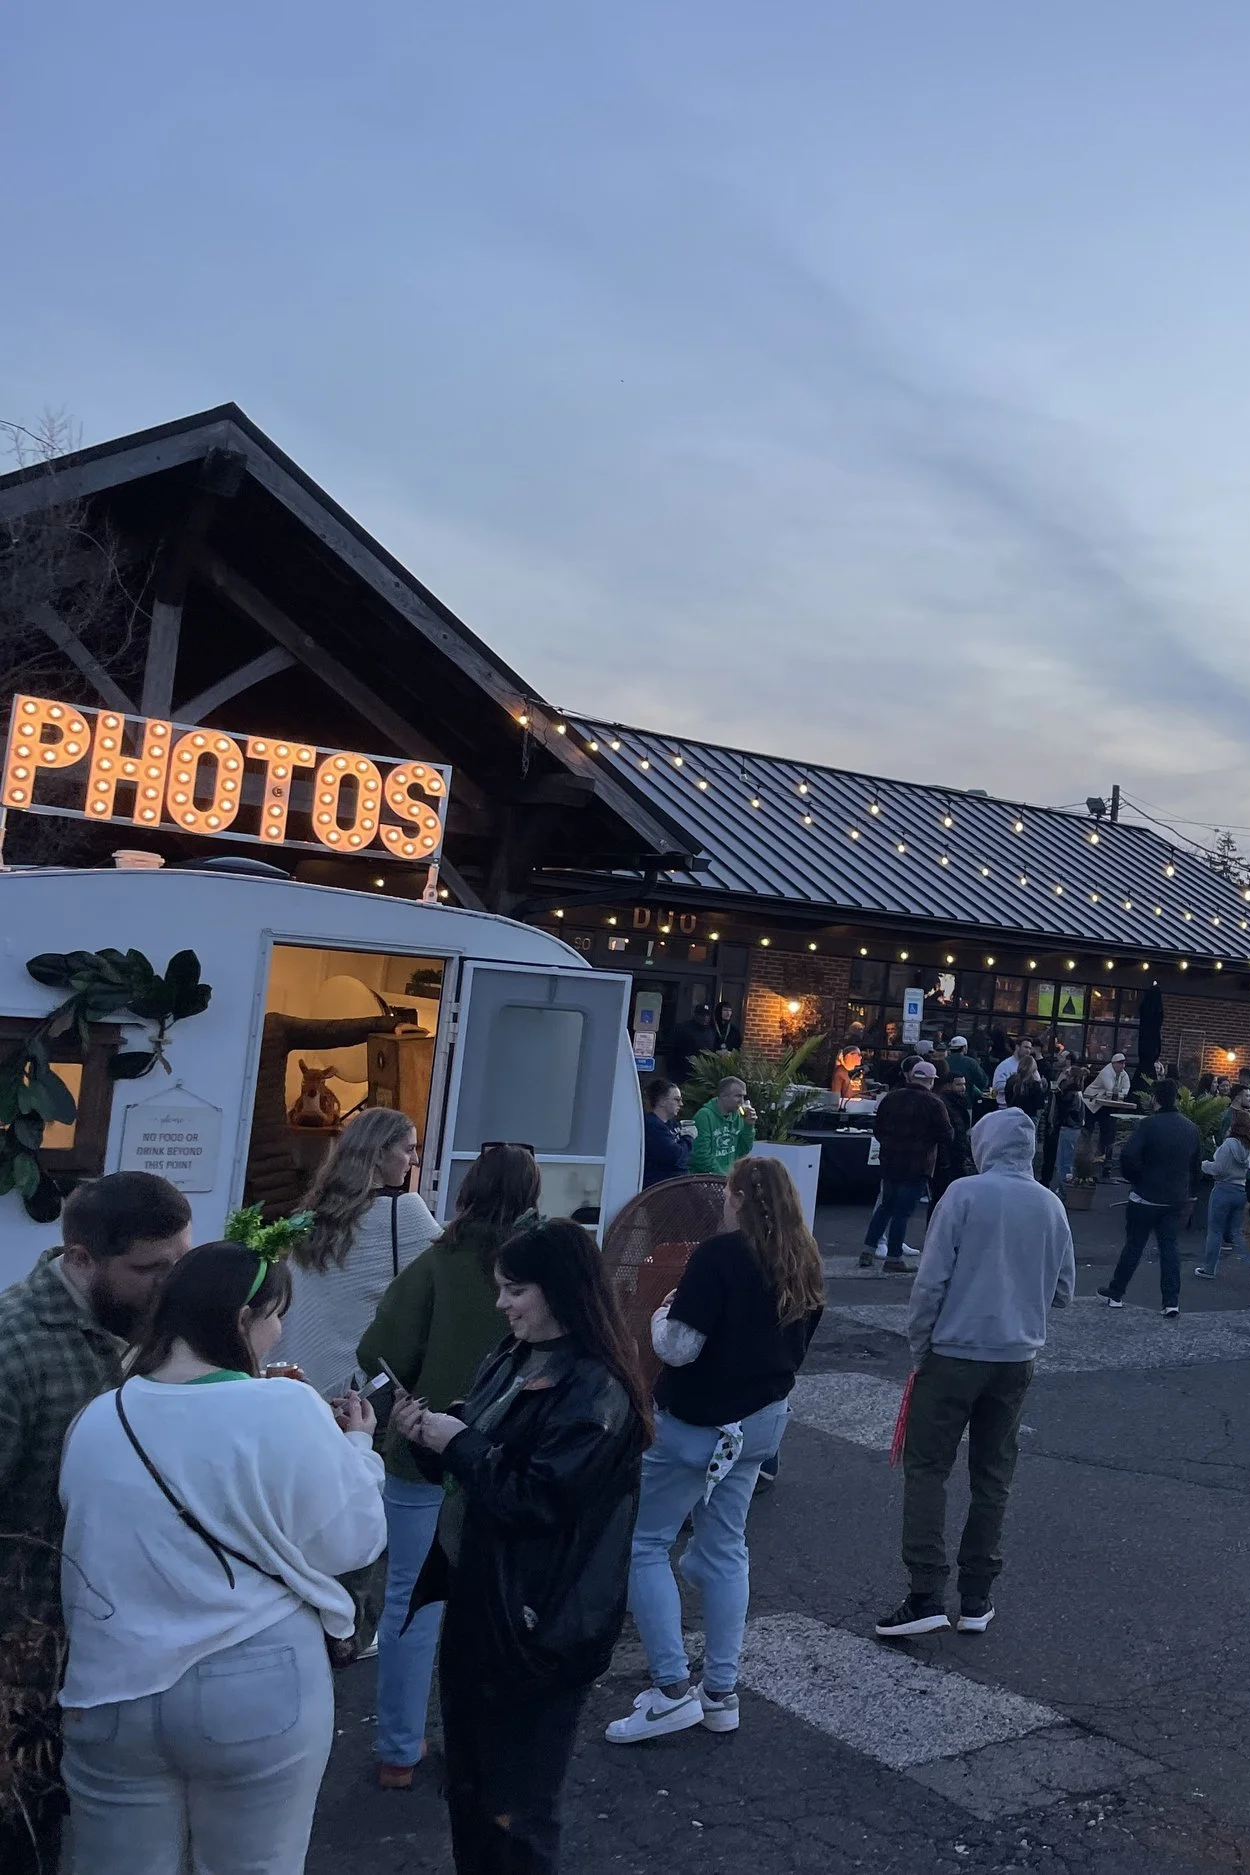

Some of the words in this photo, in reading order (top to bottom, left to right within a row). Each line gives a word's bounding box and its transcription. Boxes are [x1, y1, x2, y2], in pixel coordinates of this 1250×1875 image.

[3, 695, 447, 860] PHOTOS
[633, 907, 696, 933] DUO
[143, 1133, 156, 1142] NO
[159, 1133, 184, 1142] FOOD
[186, 1133, 199, 1142] OR
[136, 1147, 165, 1156] DRINK
[167, 1147, 202, 1156] BEYOND
[144, 1160, 164, 1170] THIS
[166, 1160, 192, 1170] POINT
